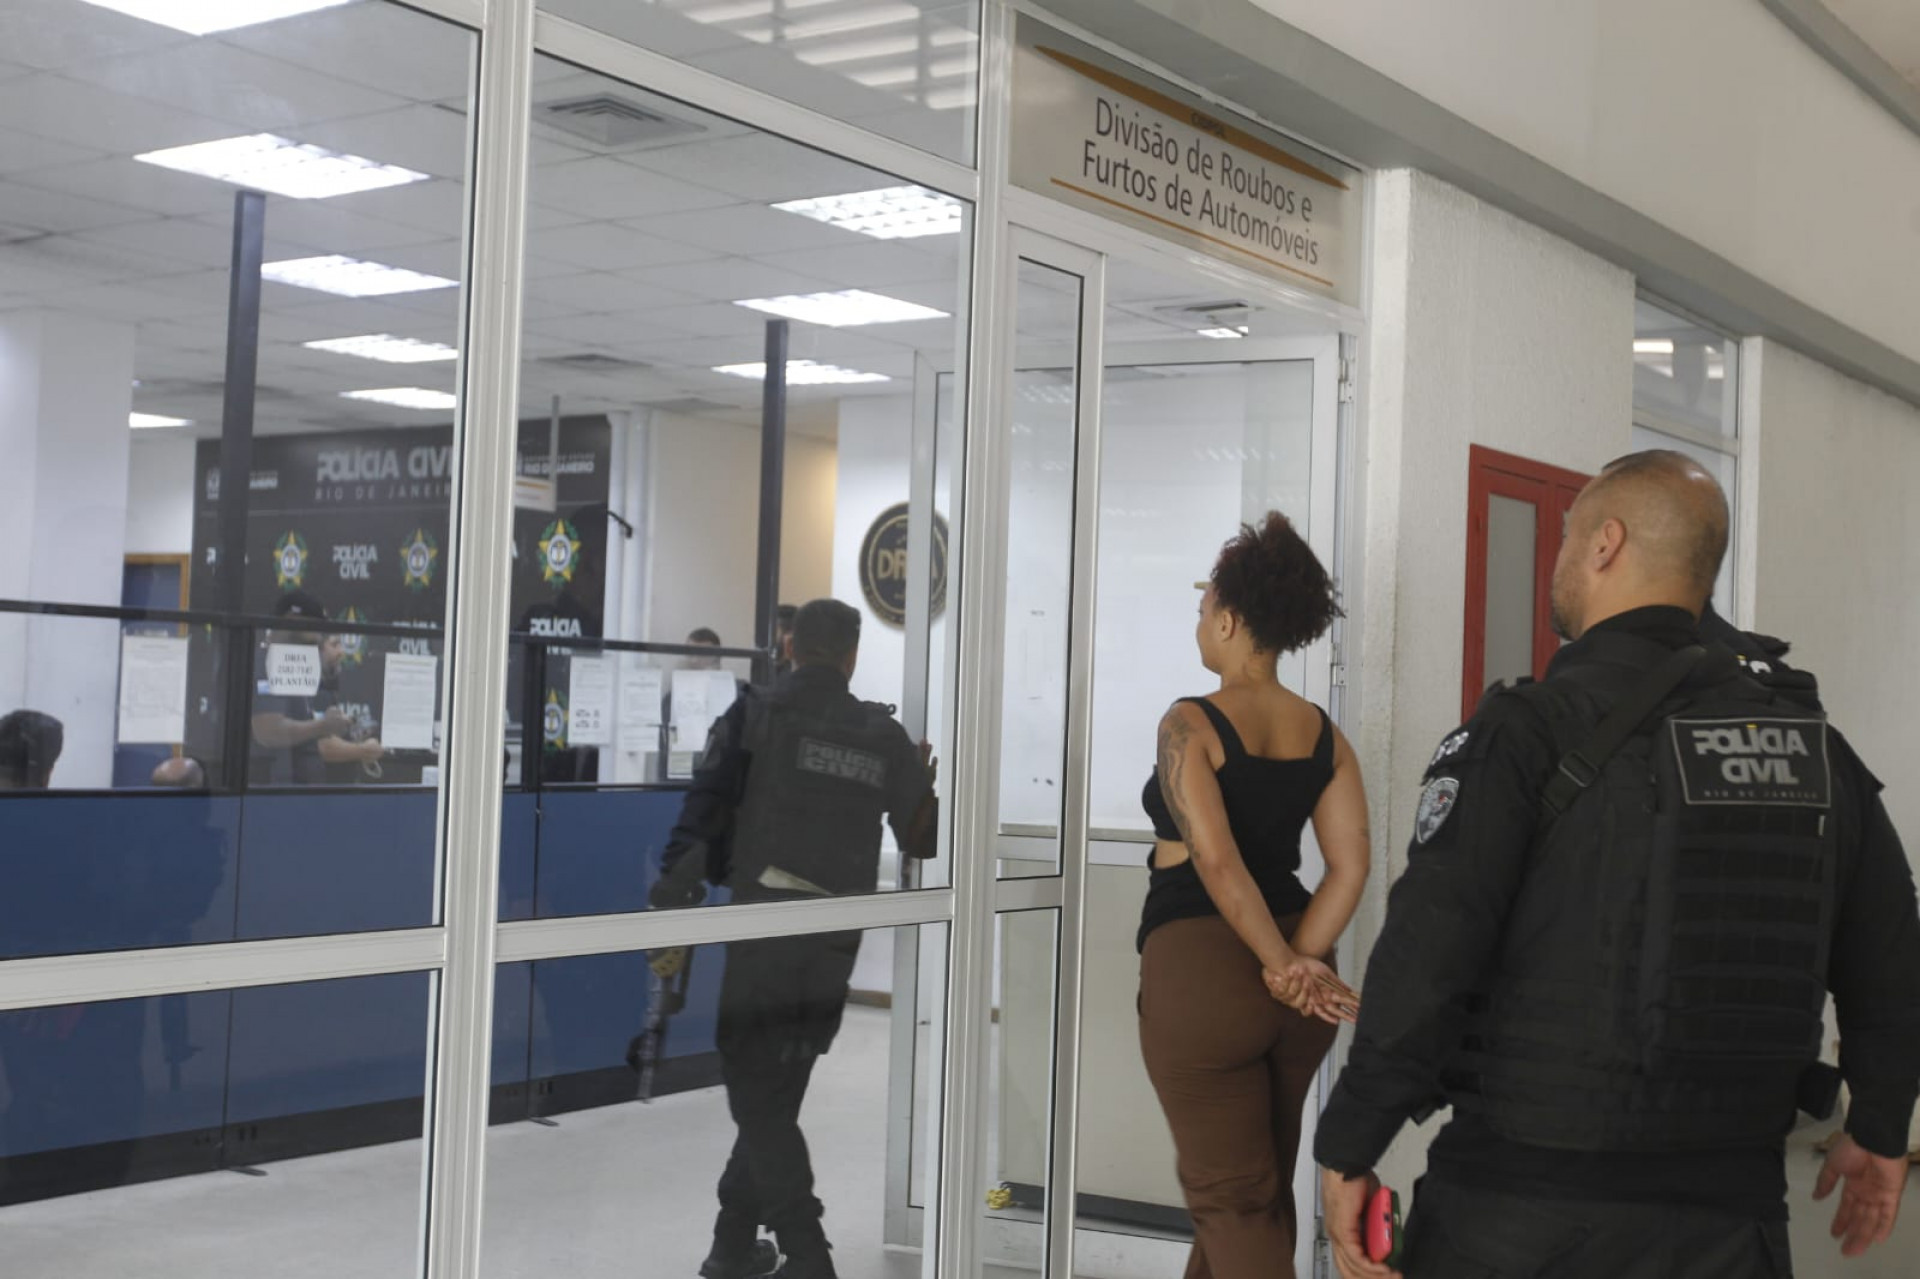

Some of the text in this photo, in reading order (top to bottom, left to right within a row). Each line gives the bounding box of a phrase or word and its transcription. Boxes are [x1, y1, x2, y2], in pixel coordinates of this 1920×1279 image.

[1095, 97, 1179, 165] Divisão
[1186, 139, 1213, 181] de
[1220, 152, 1295, 215] Roubos
[1301, 195, 1313, 223] e
[1083, 140, 1319, 266] Furtos de Automóveis
[408, 446, 452, 478] CIVI
[339, 562, 371, 580] CIVIL
[1692, 723, 1810, 757] POLÍCIA
[1721, 758, 1800, 785] CIVIL
